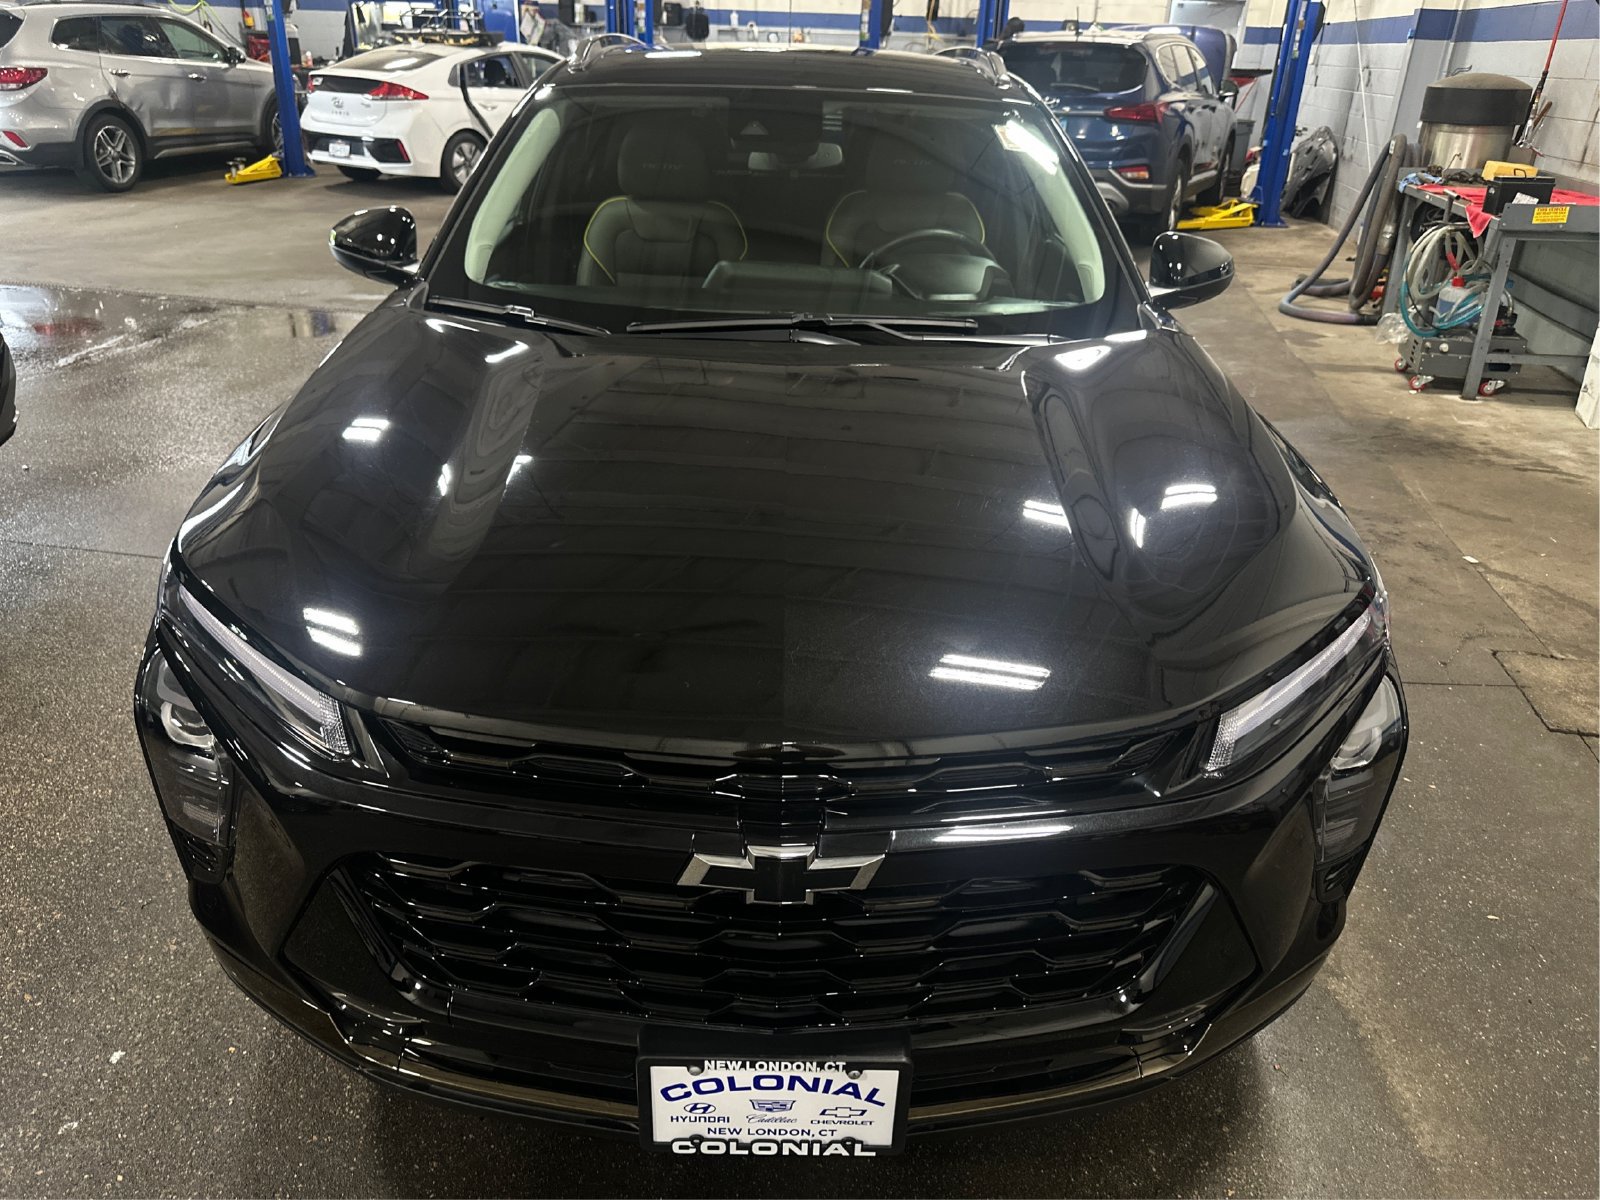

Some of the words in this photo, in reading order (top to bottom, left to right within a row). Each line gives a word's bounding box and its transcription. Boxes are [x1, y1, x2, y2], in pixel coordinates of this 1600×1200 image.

[704, 1060, 742, 1071] NEW
[824, 1062, 846, 1073] CT
[660, 1074, 886, 1107] COLONIAL
[670, 1115, 730, 1123] HYUNDAI
[746, 1113, 797, 1124] Cadillac
[707, 1127, 743, 1135] NEW
[747, 1128, 815, 1138] LONDON,
[818, 1129, 838, 1137] CT
[671, 1140, 877, 1157] COLONIAL
